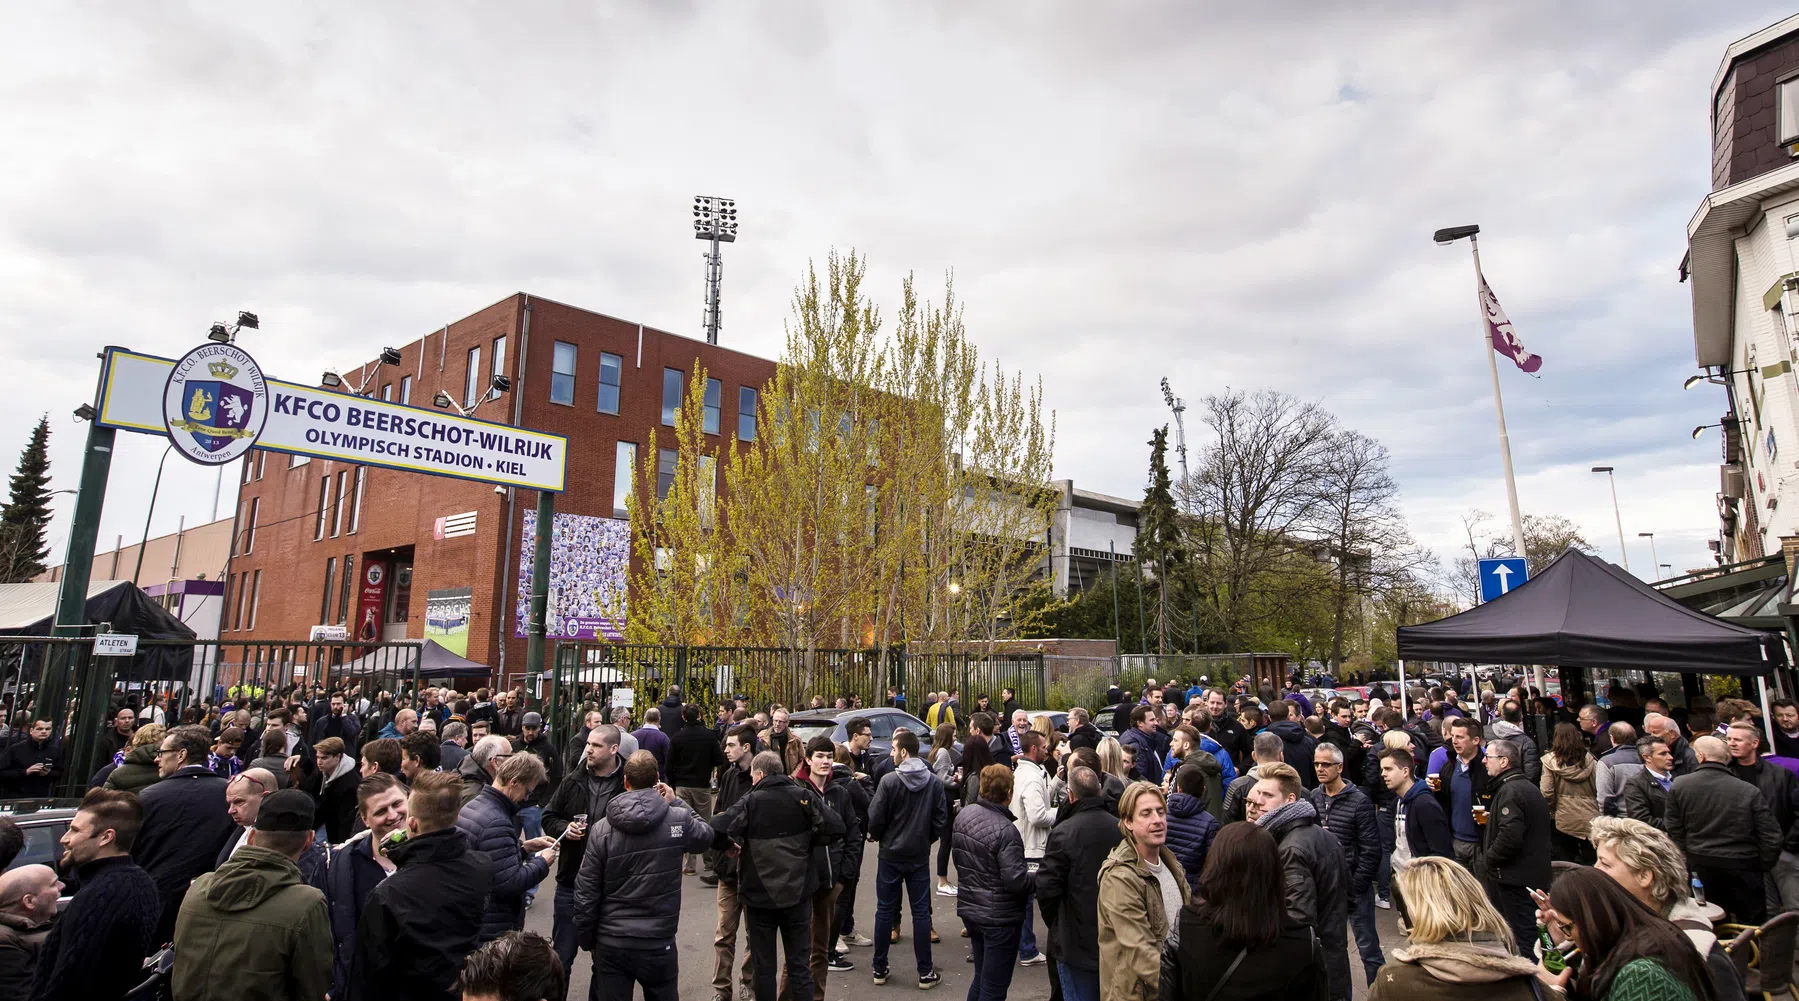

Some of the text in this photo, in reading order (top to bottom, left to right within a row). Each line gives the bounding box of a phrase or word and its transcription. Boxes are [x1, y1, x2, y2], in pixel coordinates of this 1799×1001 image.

[172, 346, 265, 399] K.F.C.O. BEERSCHOT WILRIJK
[274, 393, 553, 461] KFCO BEERSCHOT-WILRIJK
[190, 446, 232, 461] Antwerpen
[305, 428, 527, 477] OLYMPISCH STADION KIEL
[99, 639, 129, 647] ATLETEN
